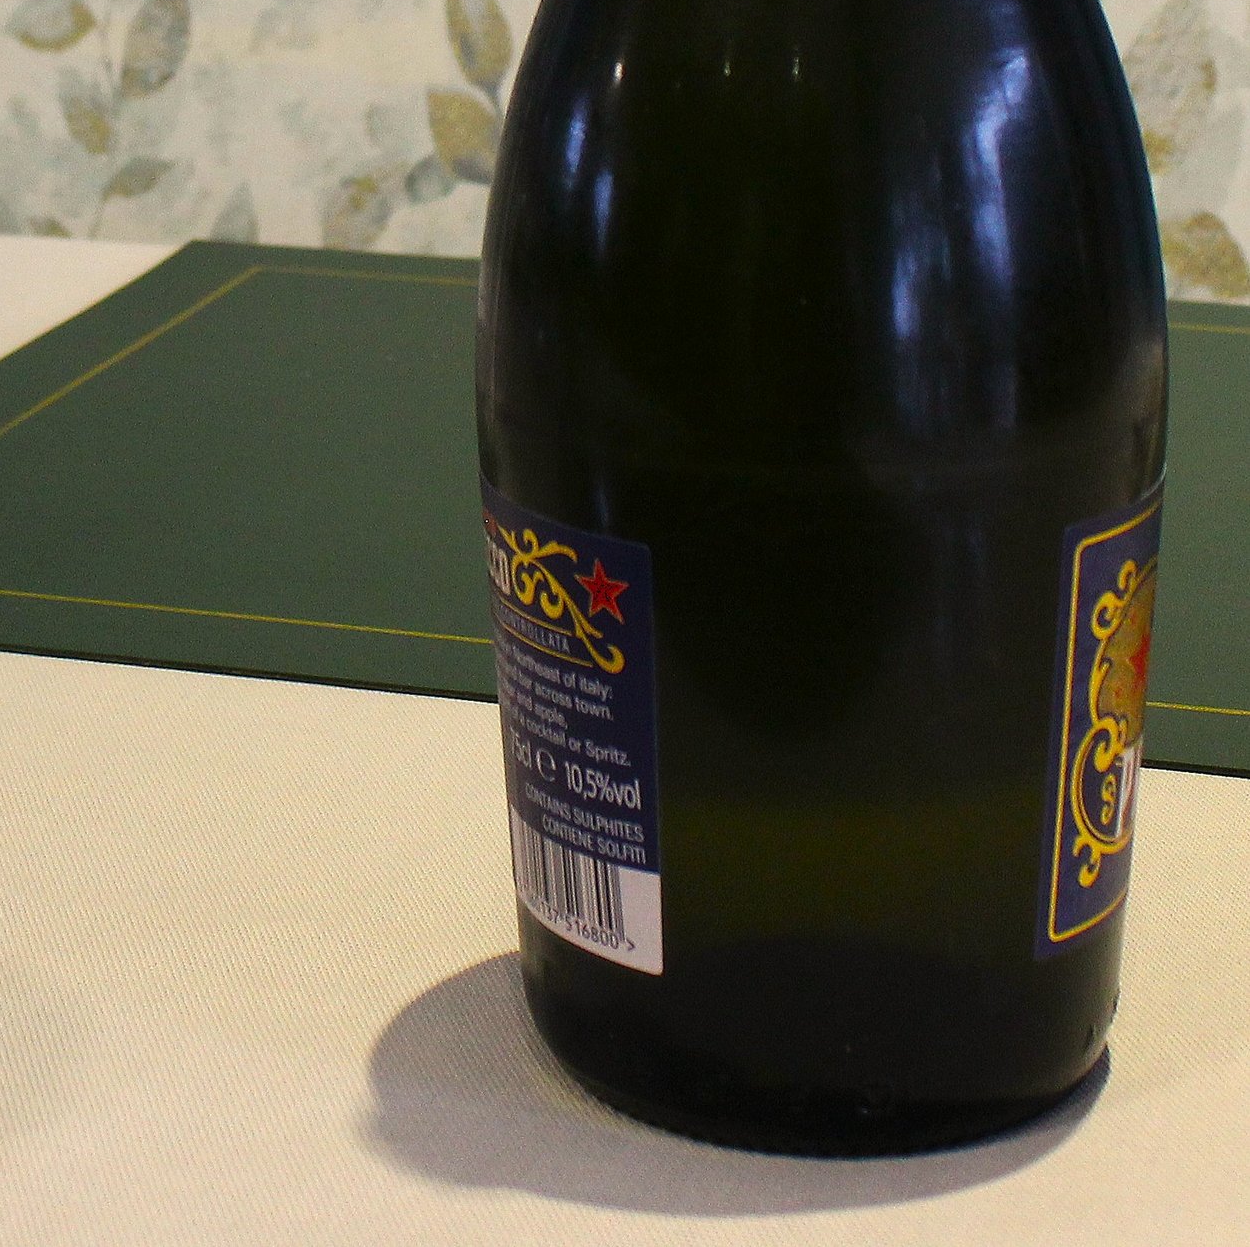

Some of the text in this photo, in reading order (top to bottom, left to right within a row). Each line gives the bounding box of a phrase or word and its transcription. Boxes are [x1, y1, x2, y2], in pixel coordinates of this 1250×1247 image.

[568, 736, 582, 754] or
[584, 738, 632, 768] Spritz.
[564, 760, 643, 811] 10,5%vol
[524, 782, 646, 843] CONTAINS SULPHITES
[542, 813, 594, 852] CONTIENE
